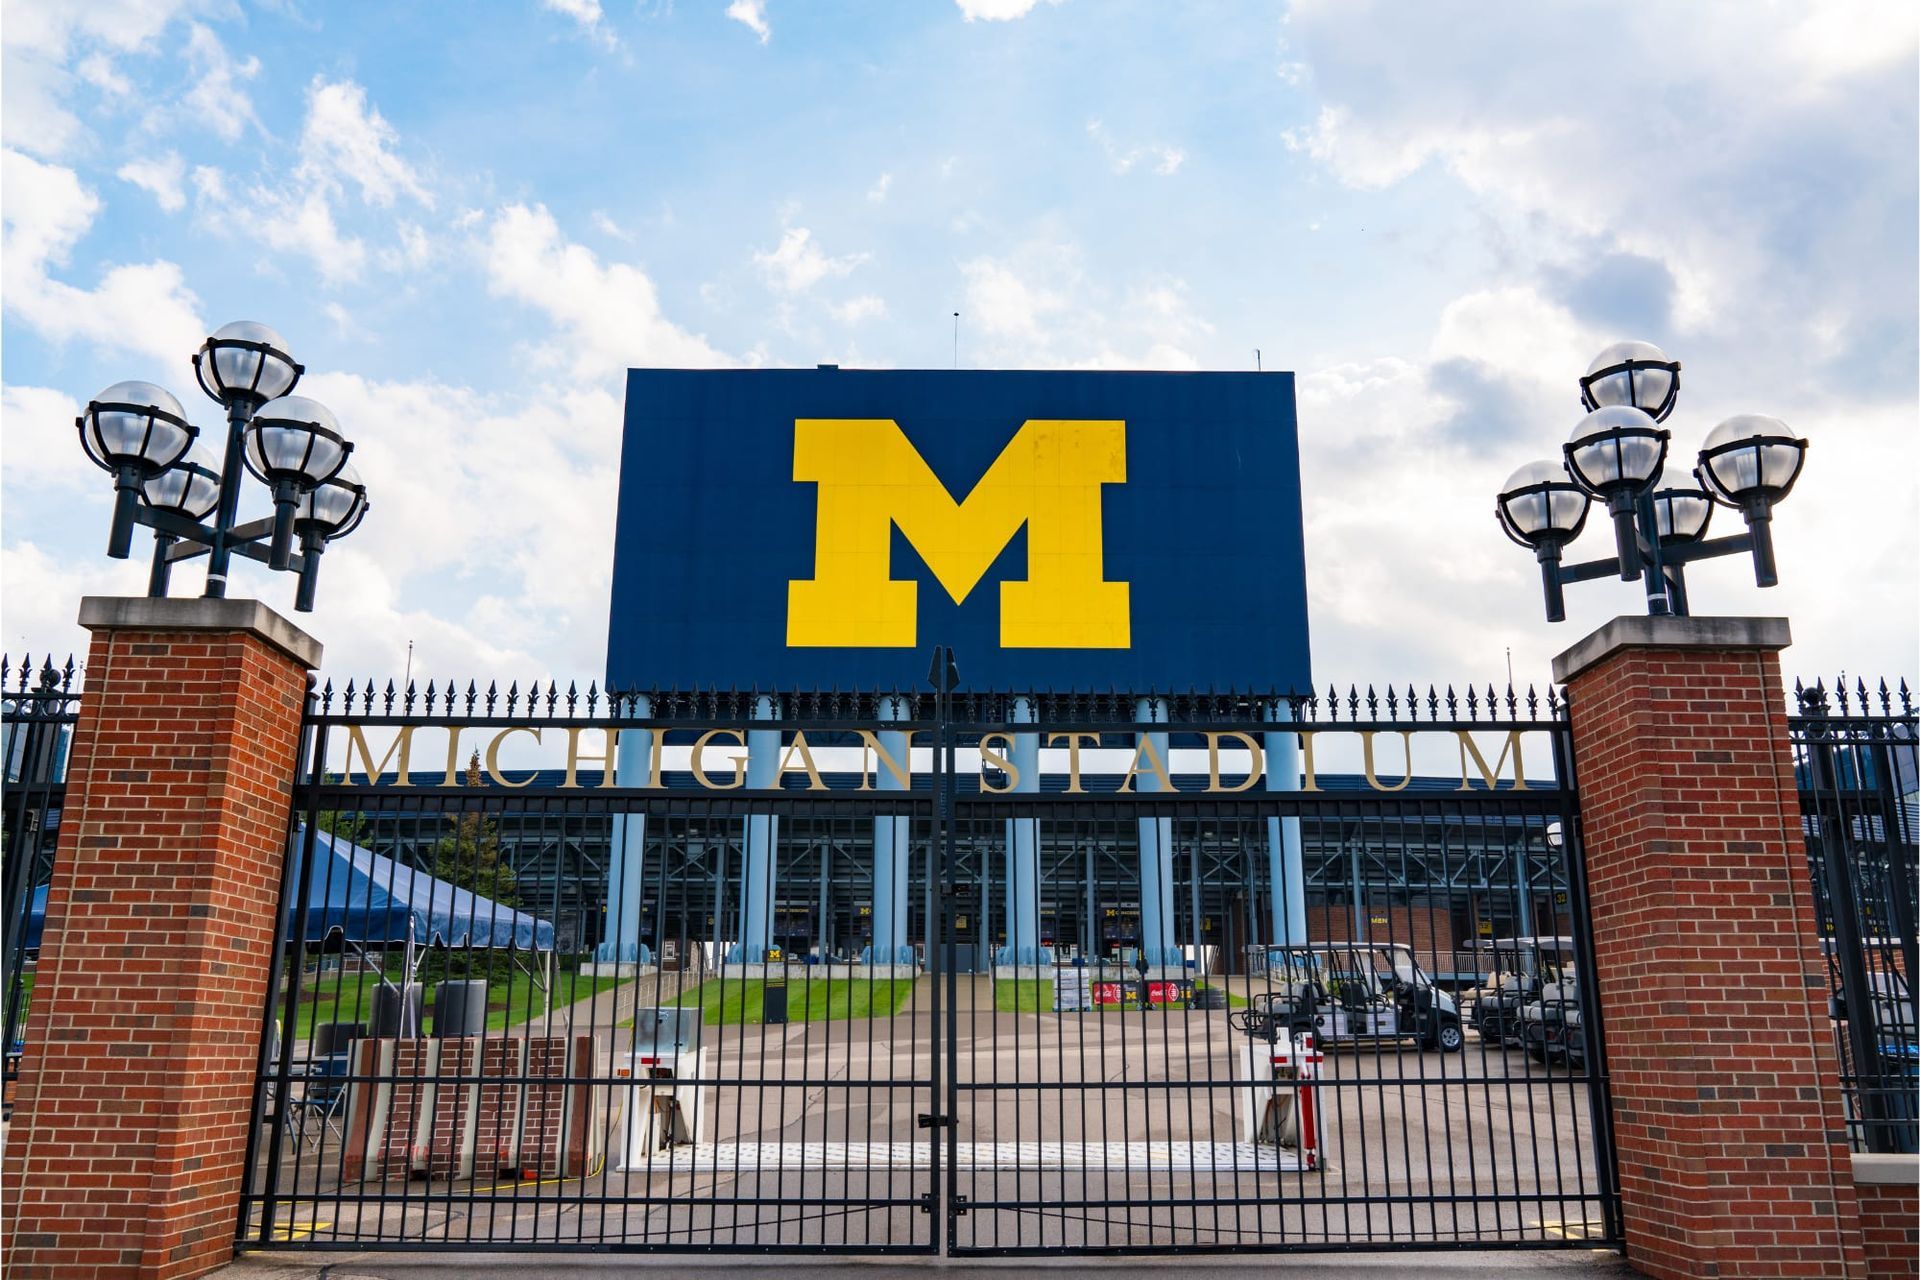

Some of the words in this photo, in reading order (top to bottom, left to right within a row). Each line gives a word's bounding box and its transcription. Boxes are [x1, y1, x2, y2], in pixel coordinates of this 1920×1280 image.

[786, 418, 1131, 648] M
[340, 726, 920, 790] MICHIGAN
[979, 730, 1532, 794] STADIUM
